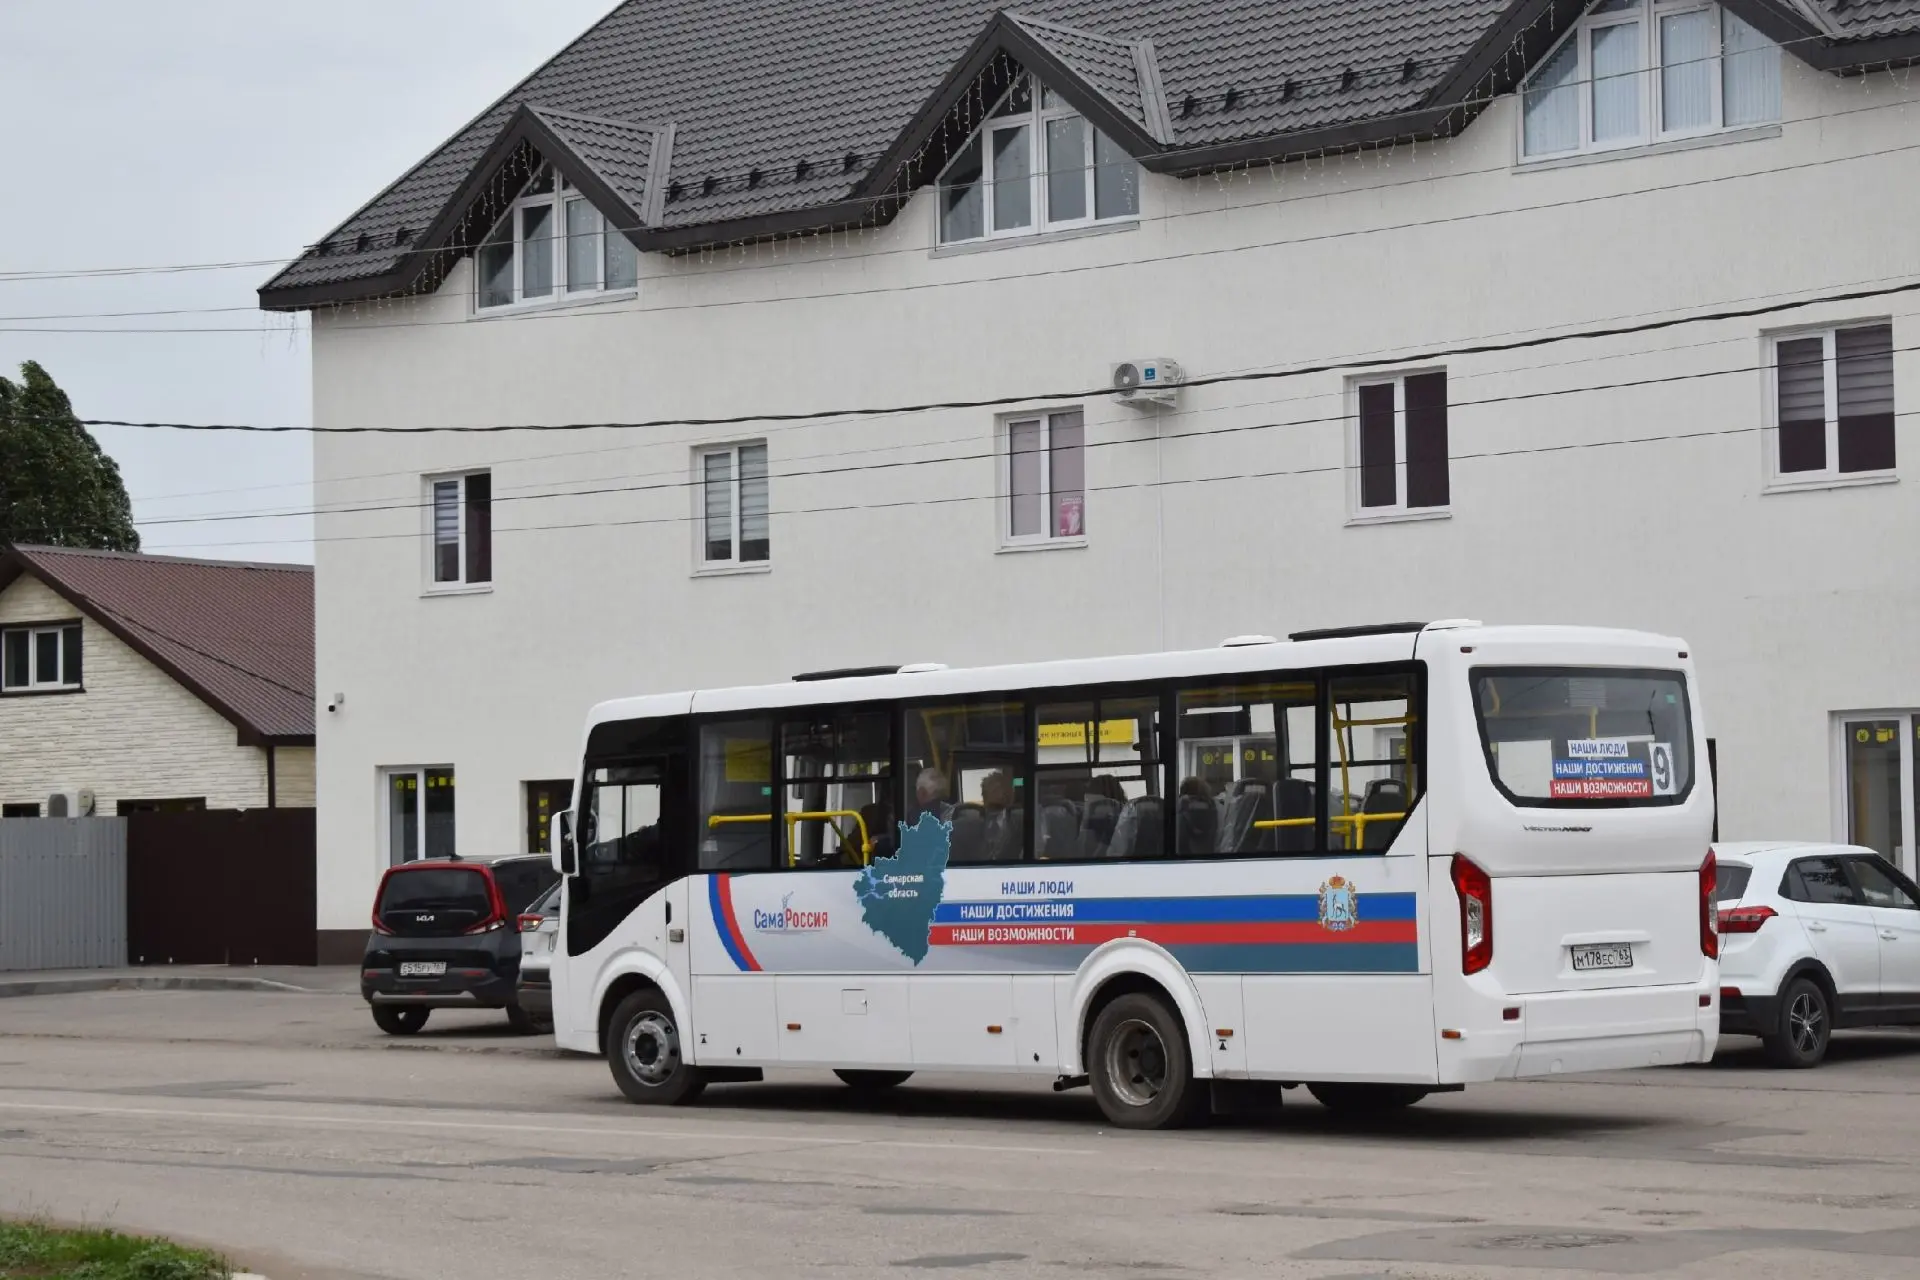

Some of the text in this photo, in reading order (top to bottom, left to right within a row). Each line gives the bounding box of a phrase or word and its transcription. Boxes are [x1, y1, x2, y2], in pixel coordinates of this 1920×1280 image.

[1571, 742, 1626, 755] НАШИ ЛЮДИ
[1555, 762, 1644, 775] НАШИ ДОСТИЖЕНИЯ
[1653, 746, 1671, 790] 9
[1554, 782, 1648, 794] НАШИ ВОЗМОЖНОСТИ
[883, 874, 924, 886] Самарская
[888, 888, 919, 899] область
[1001, 881, 1074, 895] НАШИ ЛЮДИ
[960, 903, 1074, 920] НАШИ ДОСТИЖЕНИЯ
[952, 927, 1075, 941] НАШИ ВОЗМОЖНОСТИ
